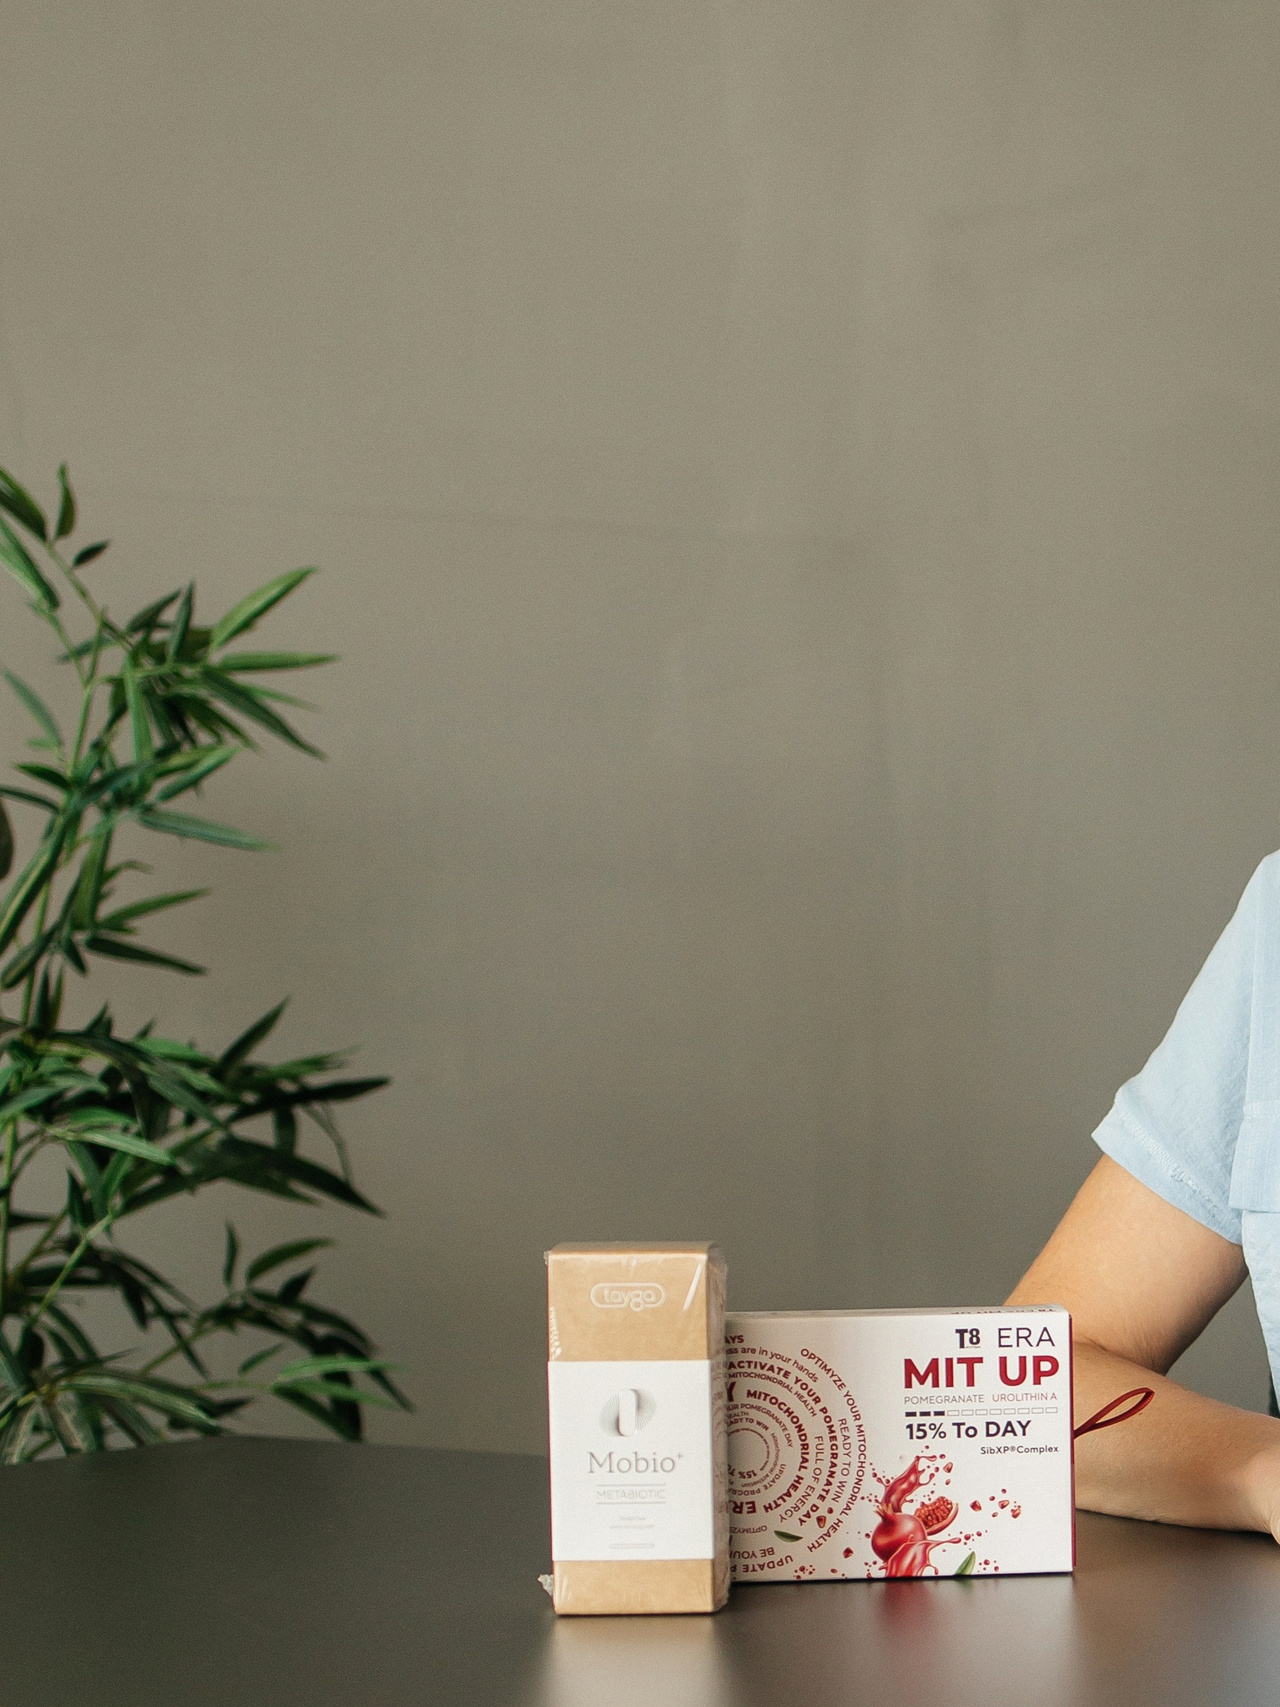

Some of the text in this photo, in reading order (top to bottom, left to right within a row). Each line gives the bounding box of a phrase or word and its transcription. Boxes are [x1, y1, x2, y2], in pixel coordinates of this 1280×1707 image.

[955, 1327, 1056, 1349] T8 ERA
[759, 1347, 768, 1356] in
[770, 1351, 792, 1364] your
[793, 1360, 818, 1383] hands
[904, 1355, 1059, 1389] MIT UP
[793, 1391, 817, 1418] HEALTH
[904, 1392, 1057, 1405] POMEGRANATE UROLITHIN A
[740, 1403, 788, 1433] POMEGRANATE
[785, 1433, 793, 1448] DAY
[746, 1389, 810, 1472] MITOCHONDRIAL
[756, 1420, 769, 1431] WIN
[906, 1420, 1031, 1440] 15% To DAY
[728, 1360, 839, 1527] ACTIVATE YOUR POMEGRANATE DAY
[800, 1348, 867, 1553] OPTIMYZE YOUR MITOCHONDRIAL HEALTH
[831, 1418, 852, 1503] READY TO WIN
[763, 1463, 786, 1491] UPDATE
[779, 1435, 825, 1523] FULL OF ENERGY
[597, 1489, 665, 1500] METABIOTIC
[729, 1500, 757, 1515] ER
[763, 1474, 804, 1514] HEALTH
[742, 1554, 794, 1573] UPDATE
[760, 1546, 775, 1557] BE
